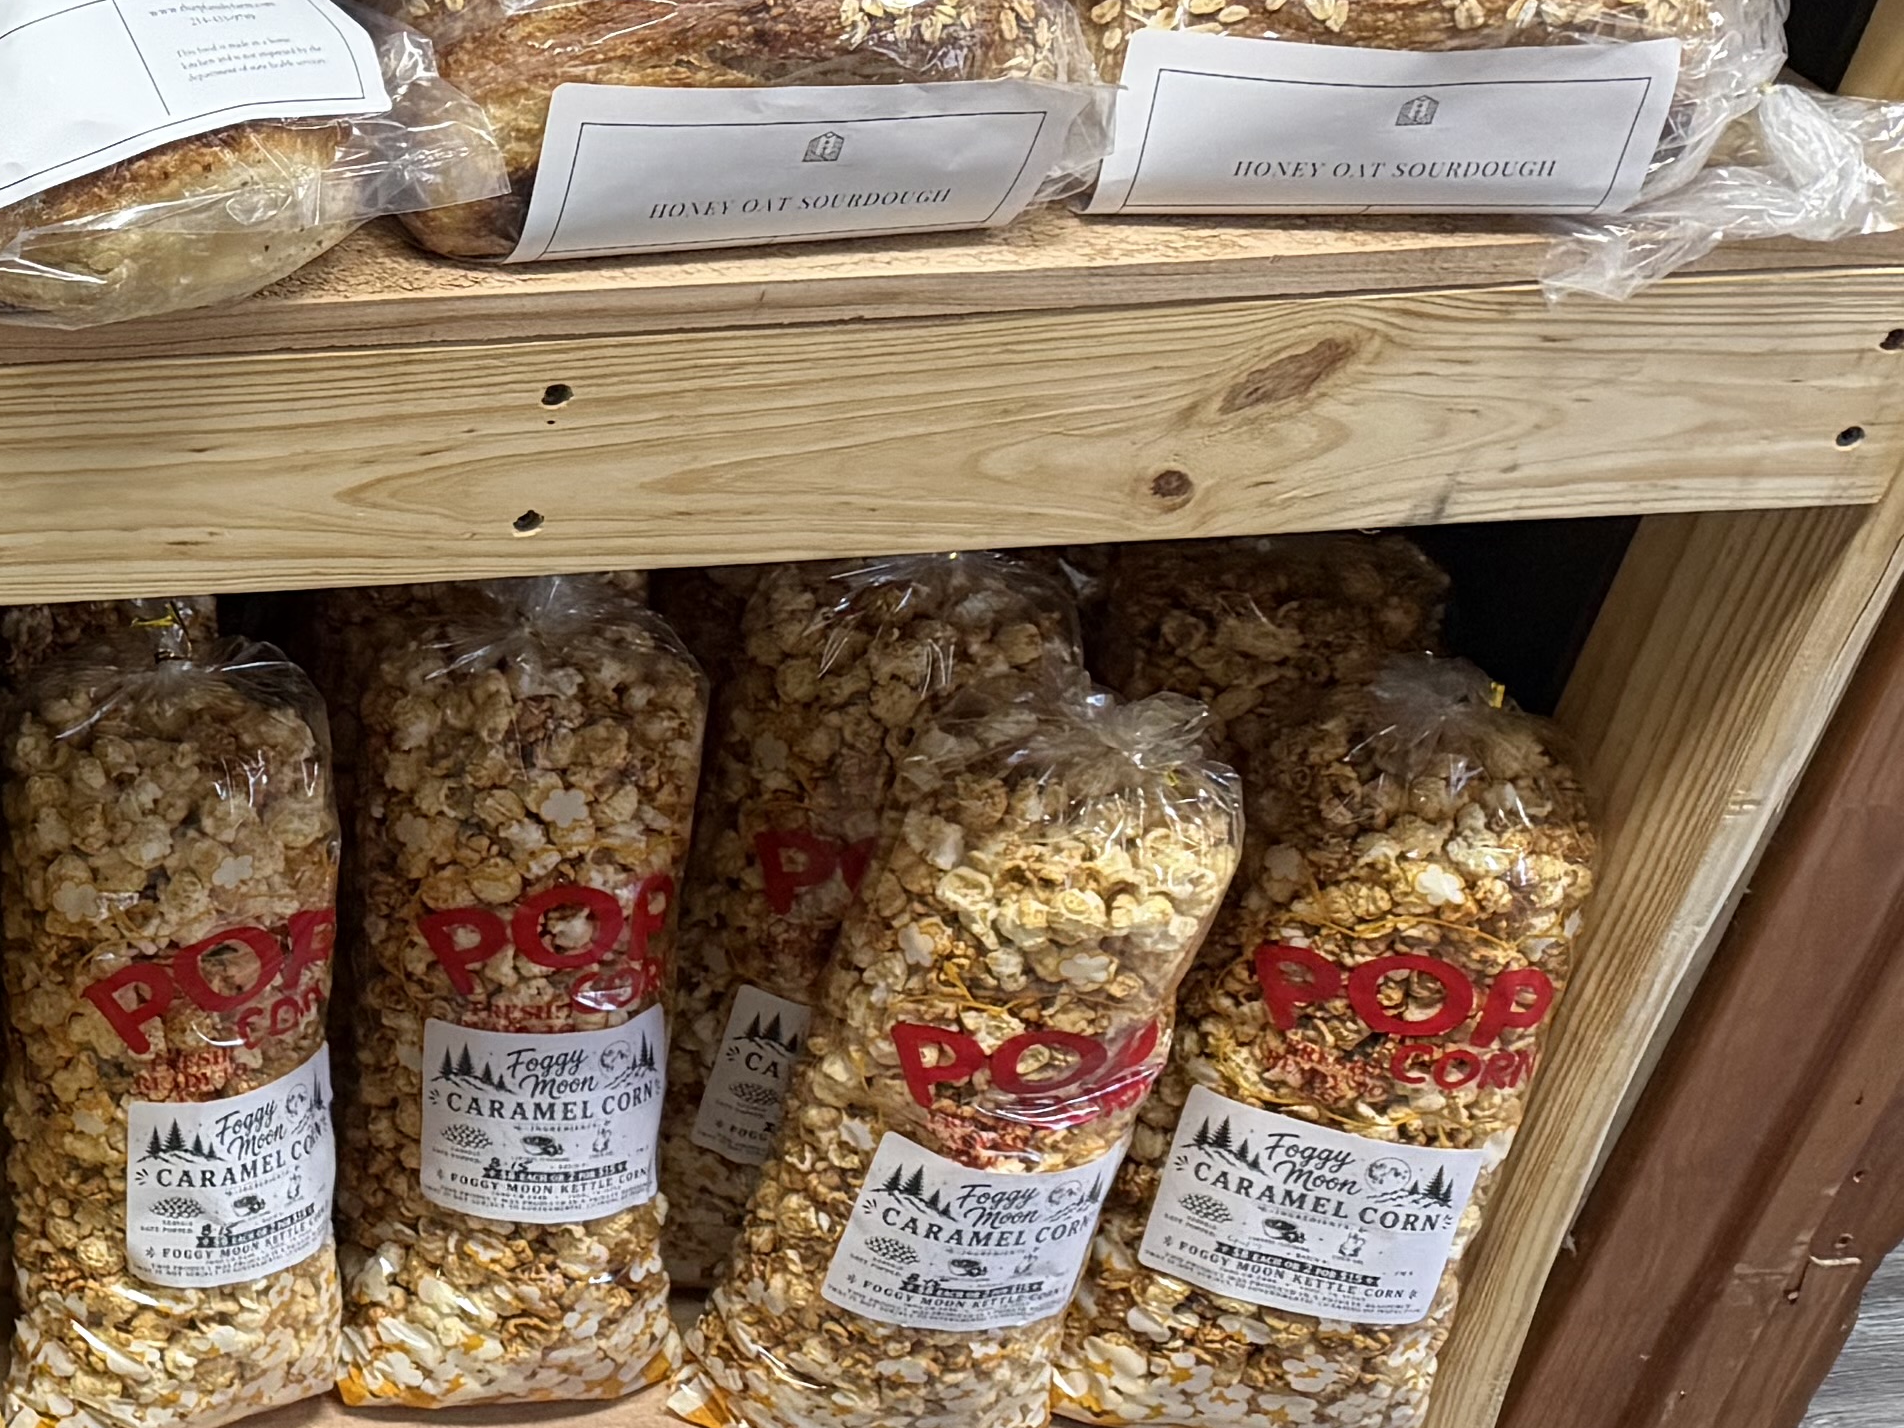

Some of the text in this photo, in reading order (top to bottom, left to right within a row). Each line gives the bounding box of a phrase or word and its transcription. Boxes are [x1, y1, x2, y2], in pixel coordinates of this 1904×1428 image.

[1233, 159, 1557, 178] HONEY OAT SOURDOUGH
[649, 187, 952, 220] HONEY OAT SOURDOUGH
[1253, 939, 1554, 1049] POP
[1393, 1043, 1538, 1091] CORN
[1265, 1132, 1356, 1173] Foggy
[1192, 1162, 1443, 1232] CARAMEL CORN
[1273, 1161, 1362, 1197] Moon
